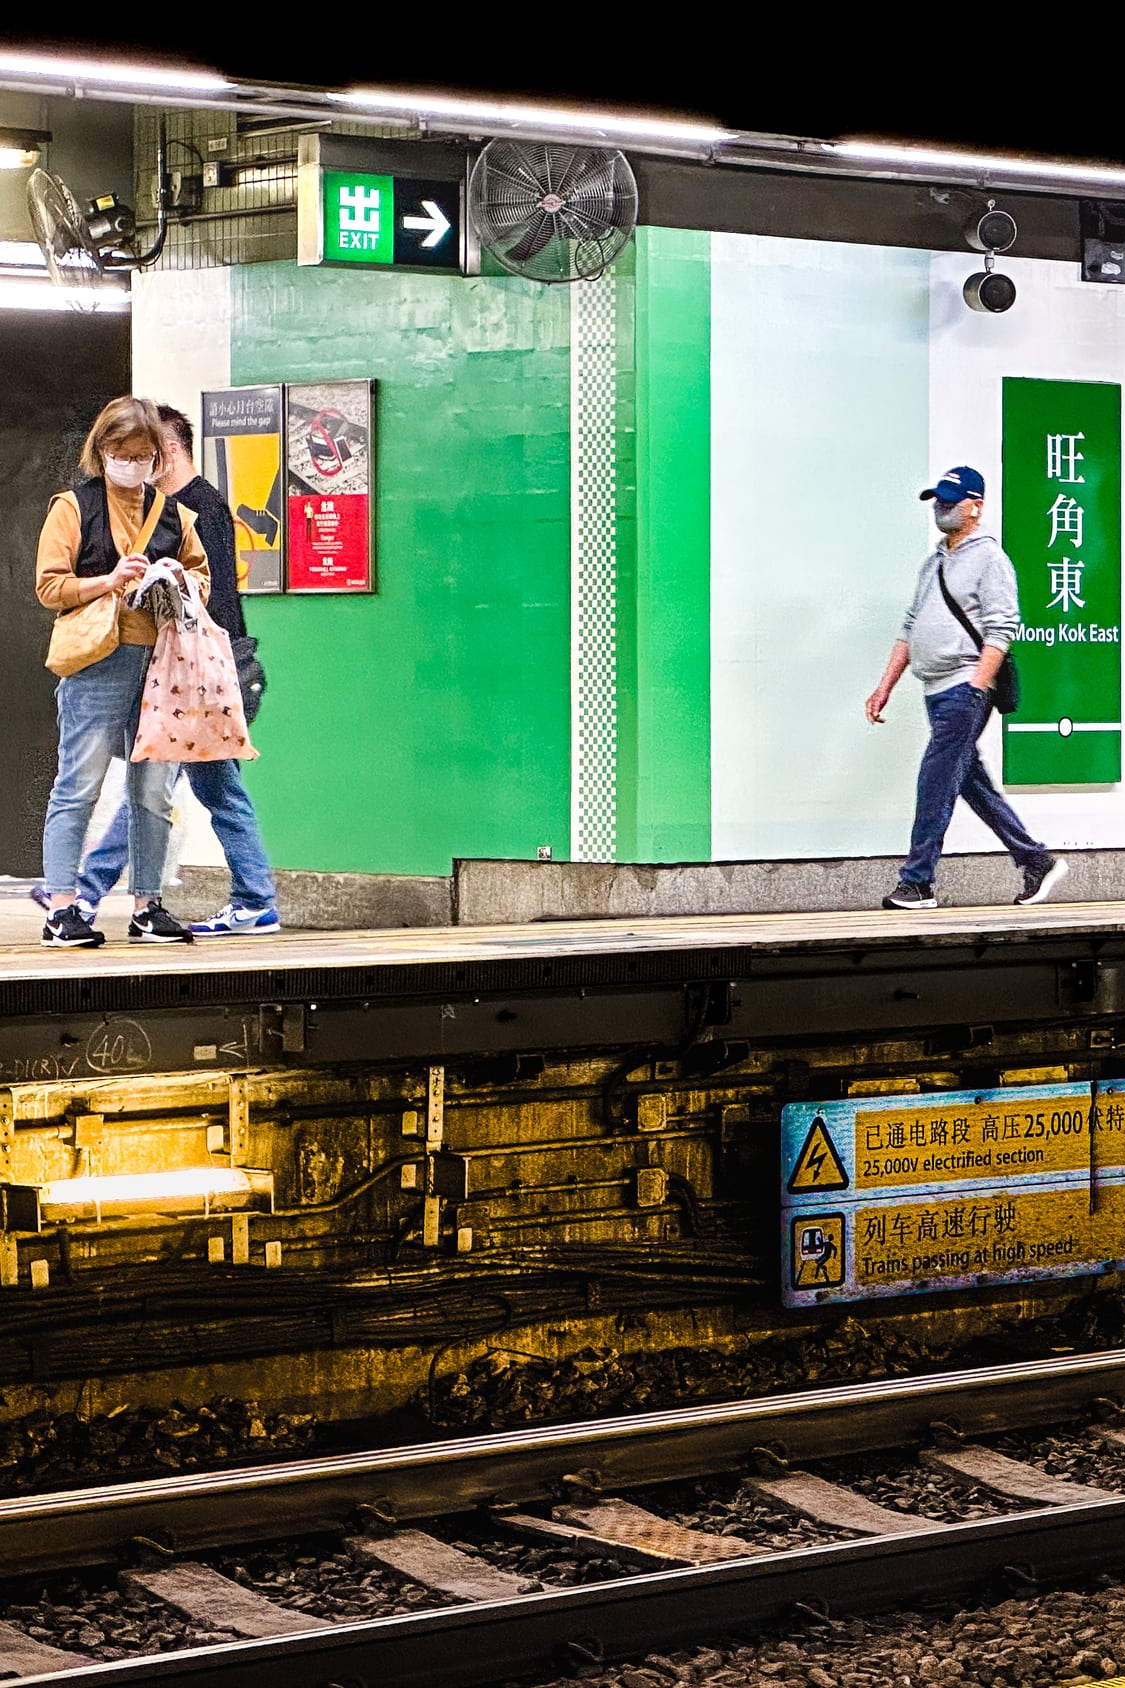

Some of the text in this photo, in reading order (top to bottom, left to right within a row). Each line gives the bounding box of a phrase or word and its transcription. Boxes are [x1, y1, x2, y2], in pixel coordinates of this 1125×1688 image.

[339, 185, 380, 232] 出
[339, 231, 380, 250] EXIT
[211, 415, 271, 428] Please mind the gap
[1045, 431, 1086, 613] 旺角東
[1012, 622, 1119, 647] Mong Kok East
[864, 1118, 972, 1151] 已通电路段
[863, 1148, 1044, 1178] 25,000V electrified section
[863, 1202, 1017, 1247] 列车高速行驶
[862, 1235, 1073, 1277] Trains passing at high speed
